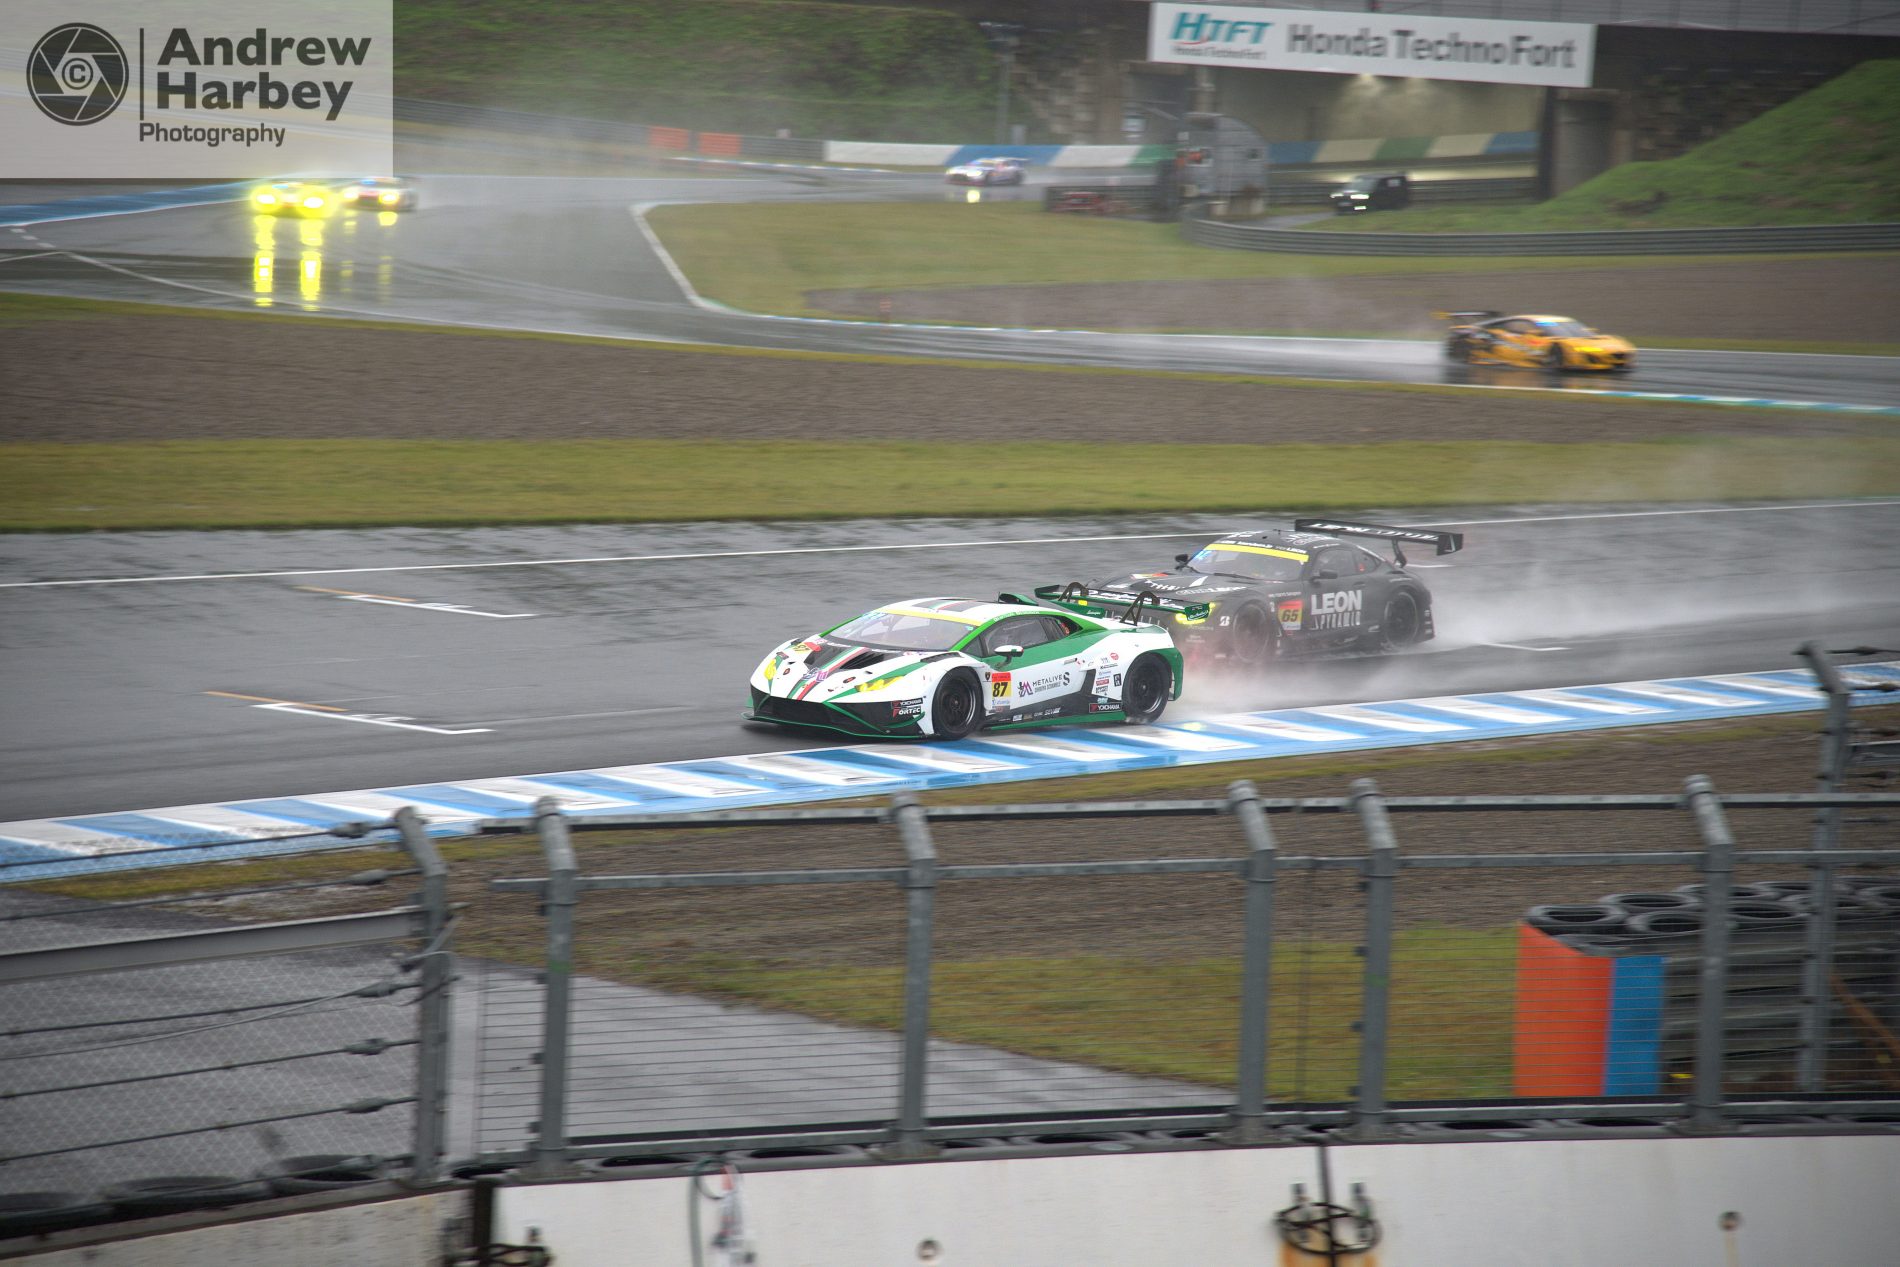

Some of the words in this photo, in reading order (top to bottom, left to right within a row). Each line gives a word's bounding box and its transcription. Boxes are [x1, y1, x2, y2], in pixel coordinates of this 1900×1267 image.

[1286, 23, 1387, 57] Honda
[1311, 589, 1362, 615] LEON
[1281, 609, 1299, 622] 65
[1032, 673, 1063, 687] METALIVE
[1063, 671, 1070, 686] S
[992, 681, 1008, 697] 87
